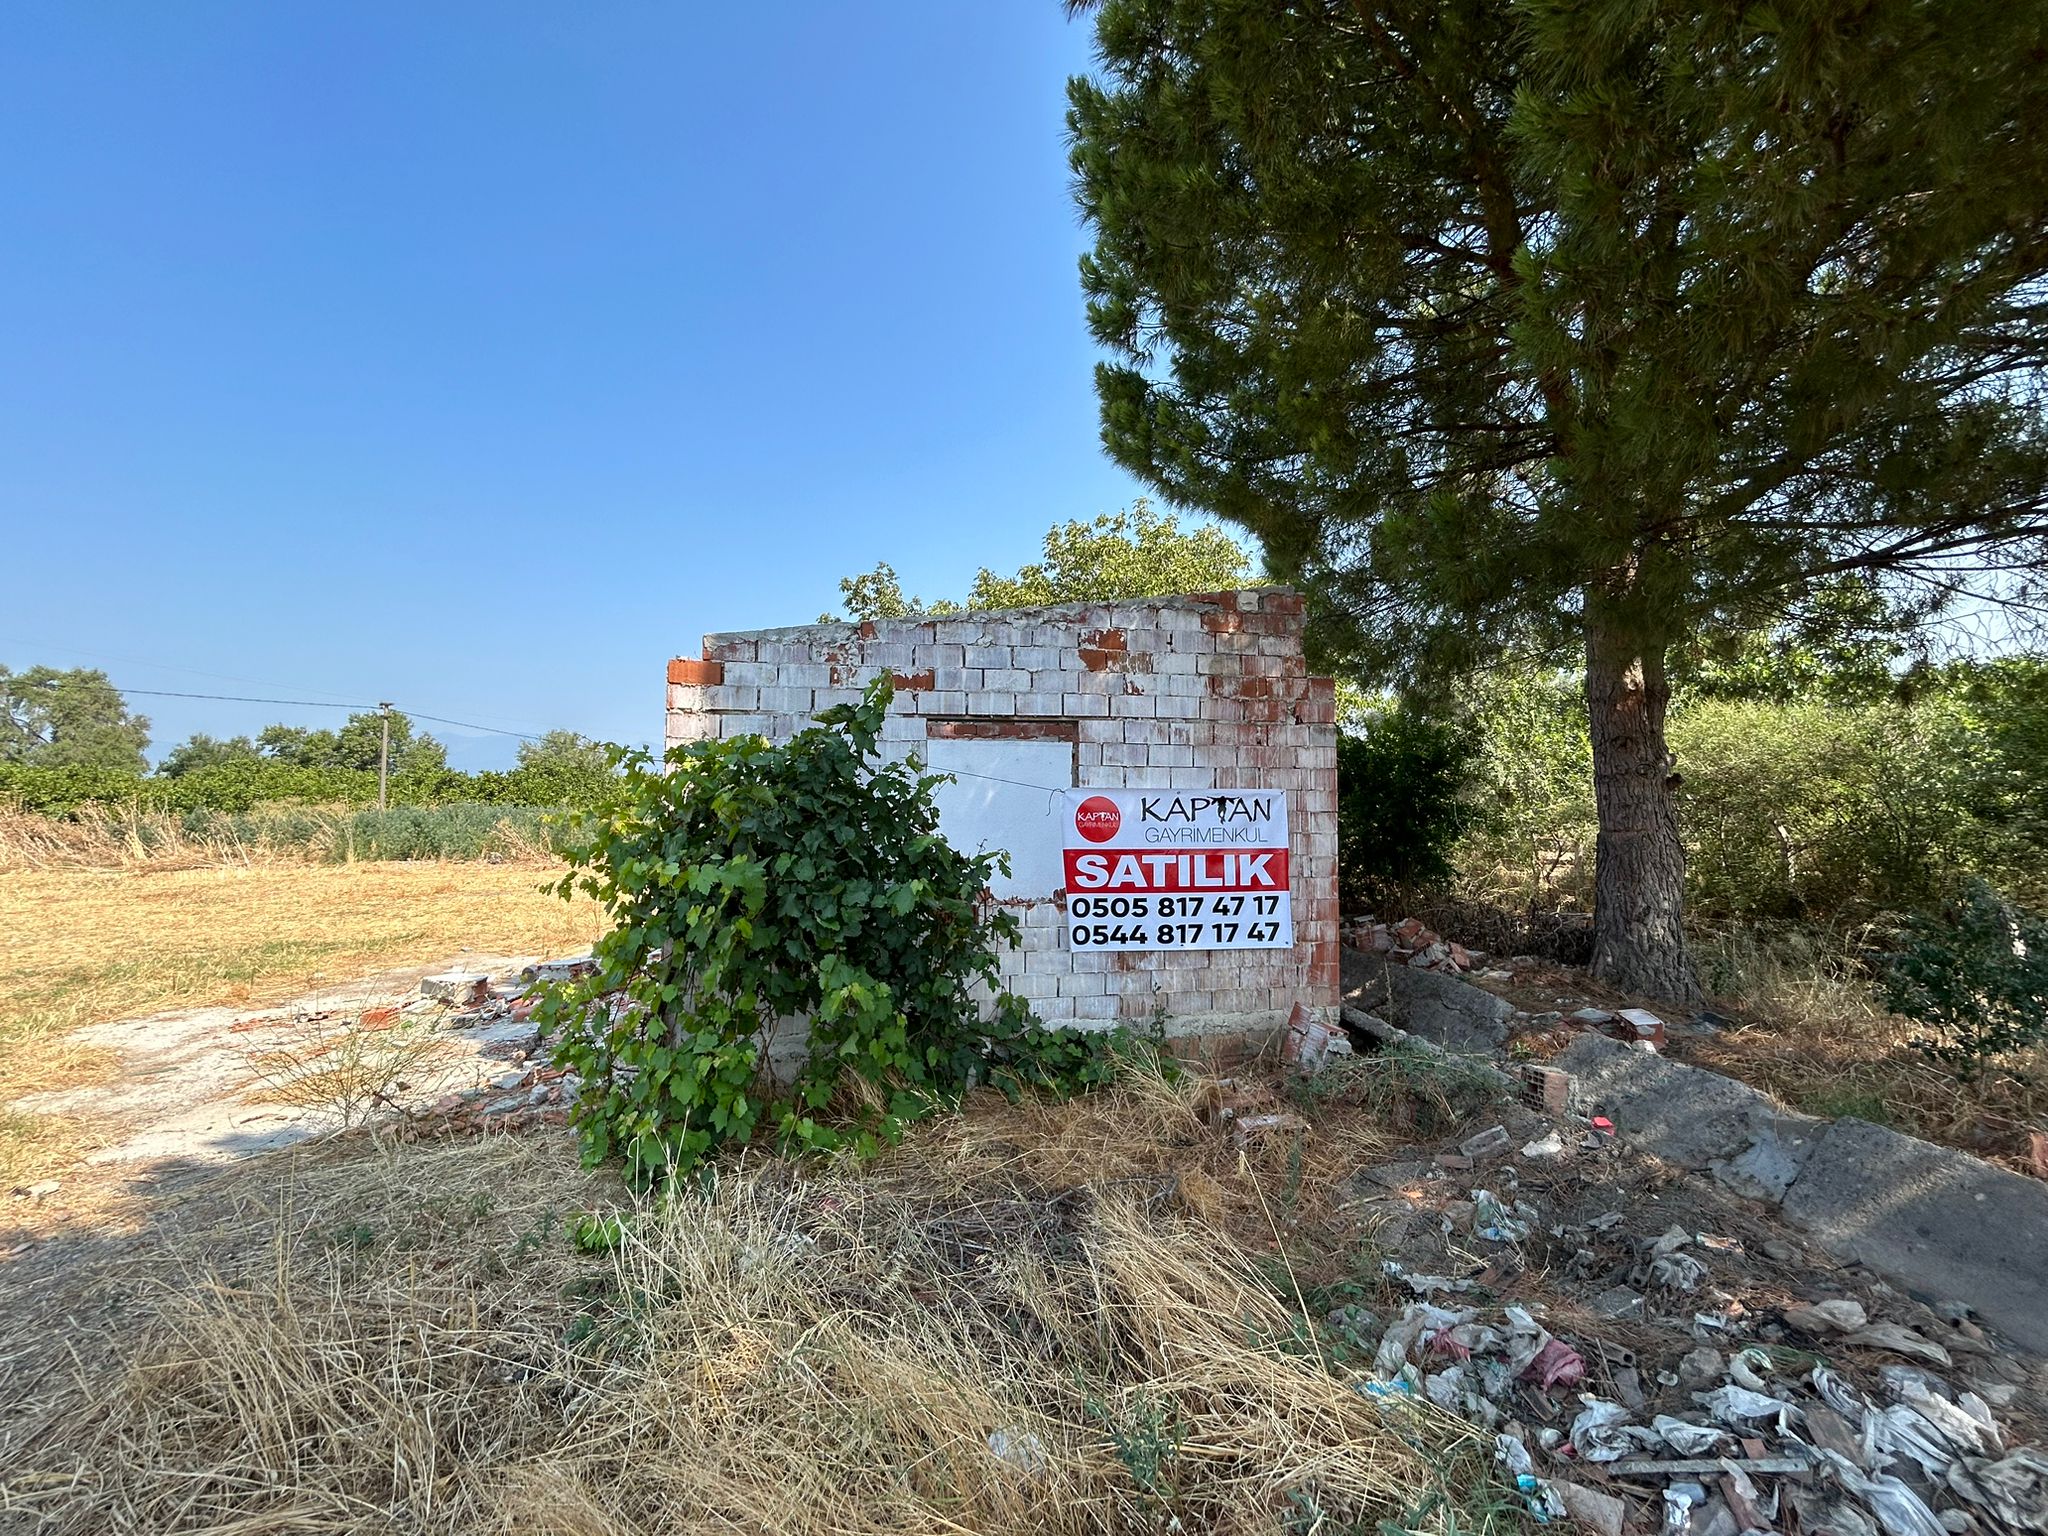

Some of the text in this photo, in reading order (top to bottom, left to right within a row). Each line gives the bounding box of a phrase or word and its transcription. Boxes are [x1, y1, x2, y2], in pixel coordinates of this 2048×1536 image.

[1078, 812, 1119, 821] KAPTAN
[1141, 796, 1271, 823] KAPTAN
[1075, 854, 1275, 887] SATILIK
[1072, 896, 1279, 917] 0505 817 47 17
[1072, 923, 1280, 944] 0544 817 17 47
